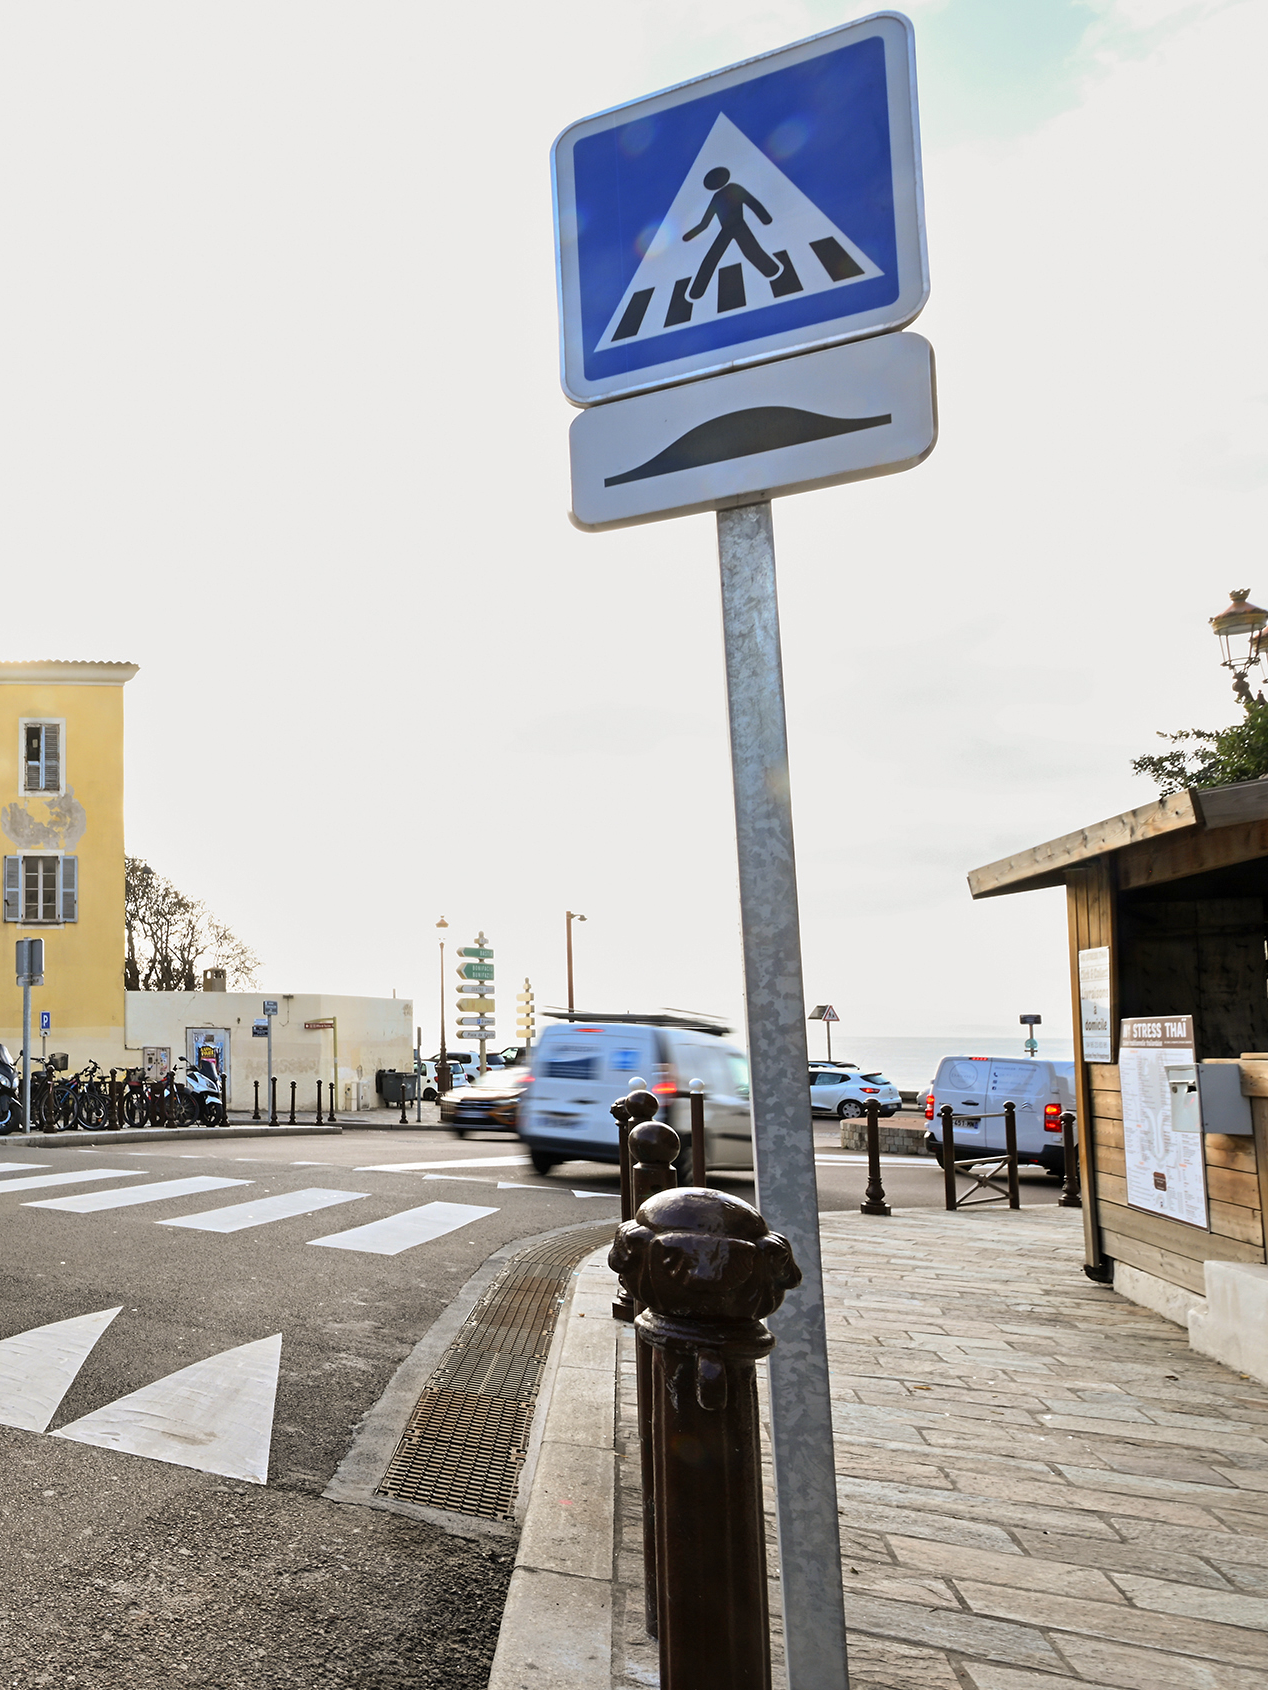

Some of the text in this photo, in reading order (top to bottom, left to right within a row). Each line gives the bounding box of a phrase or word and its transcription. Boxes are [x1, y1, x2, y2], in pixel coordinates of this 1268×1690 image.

[43, 1015, 49, 1027] P
[1085, 1018, 1107, 1031] domicile
[1133, 1022, 1162, 1038] STRESS
[1164, 1018, 1187, 1038] THAÏ
